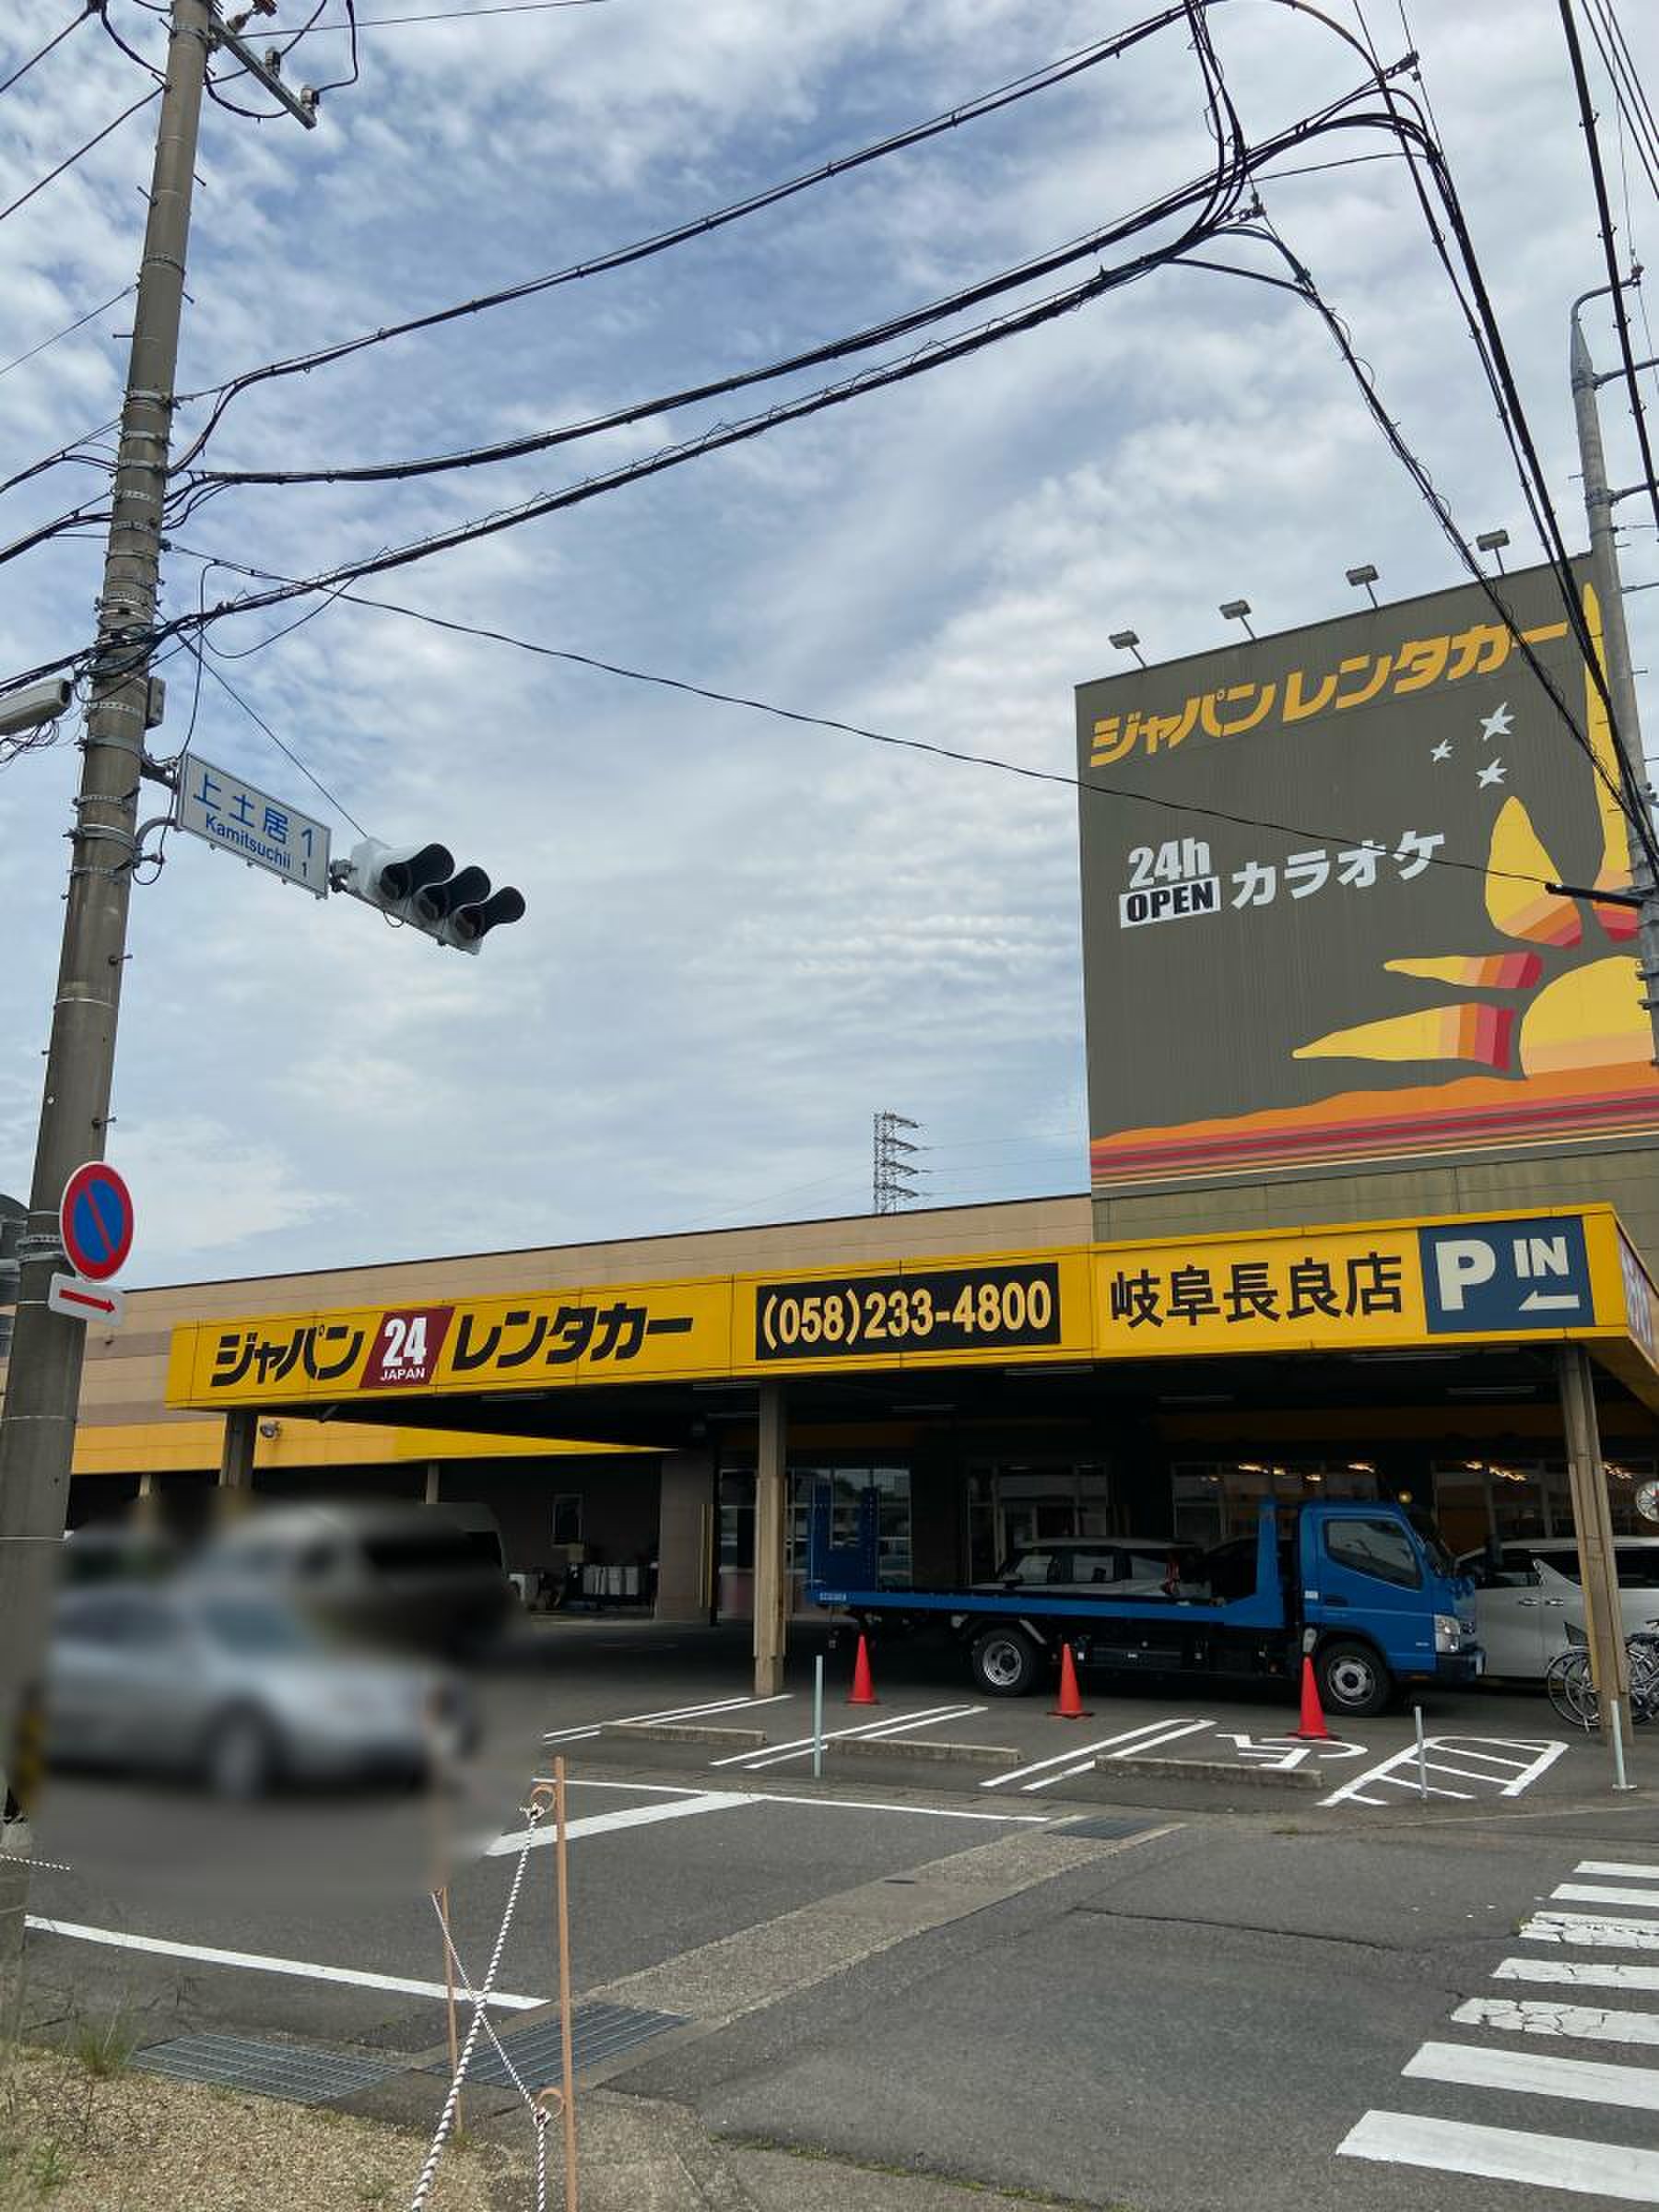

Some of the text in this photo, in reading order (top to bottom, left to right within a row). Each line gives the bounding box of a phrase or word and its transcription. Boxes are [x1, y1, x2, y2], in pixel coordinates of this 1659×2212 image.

[301, 861, 308, 877] 1
[1128, 837, 1211, 889] 24h
[1231, 830, 1445, 911] カラオケ
[1126, 879, 1215, 923] OPEN
[1110, 1251, 1402, 1328] 岐阜長良店
[1435, 1236, 1570, 1312] P IN
[382, 1316, 428, 1367] 24
[452, 1301, 694, 1372] レンタカー
[763, 1279, 1053, 1351] (058)233-4800
[210, 1324, 365, 1387] ジャパン
[380, 1366, 426, 1382] JAPAN
